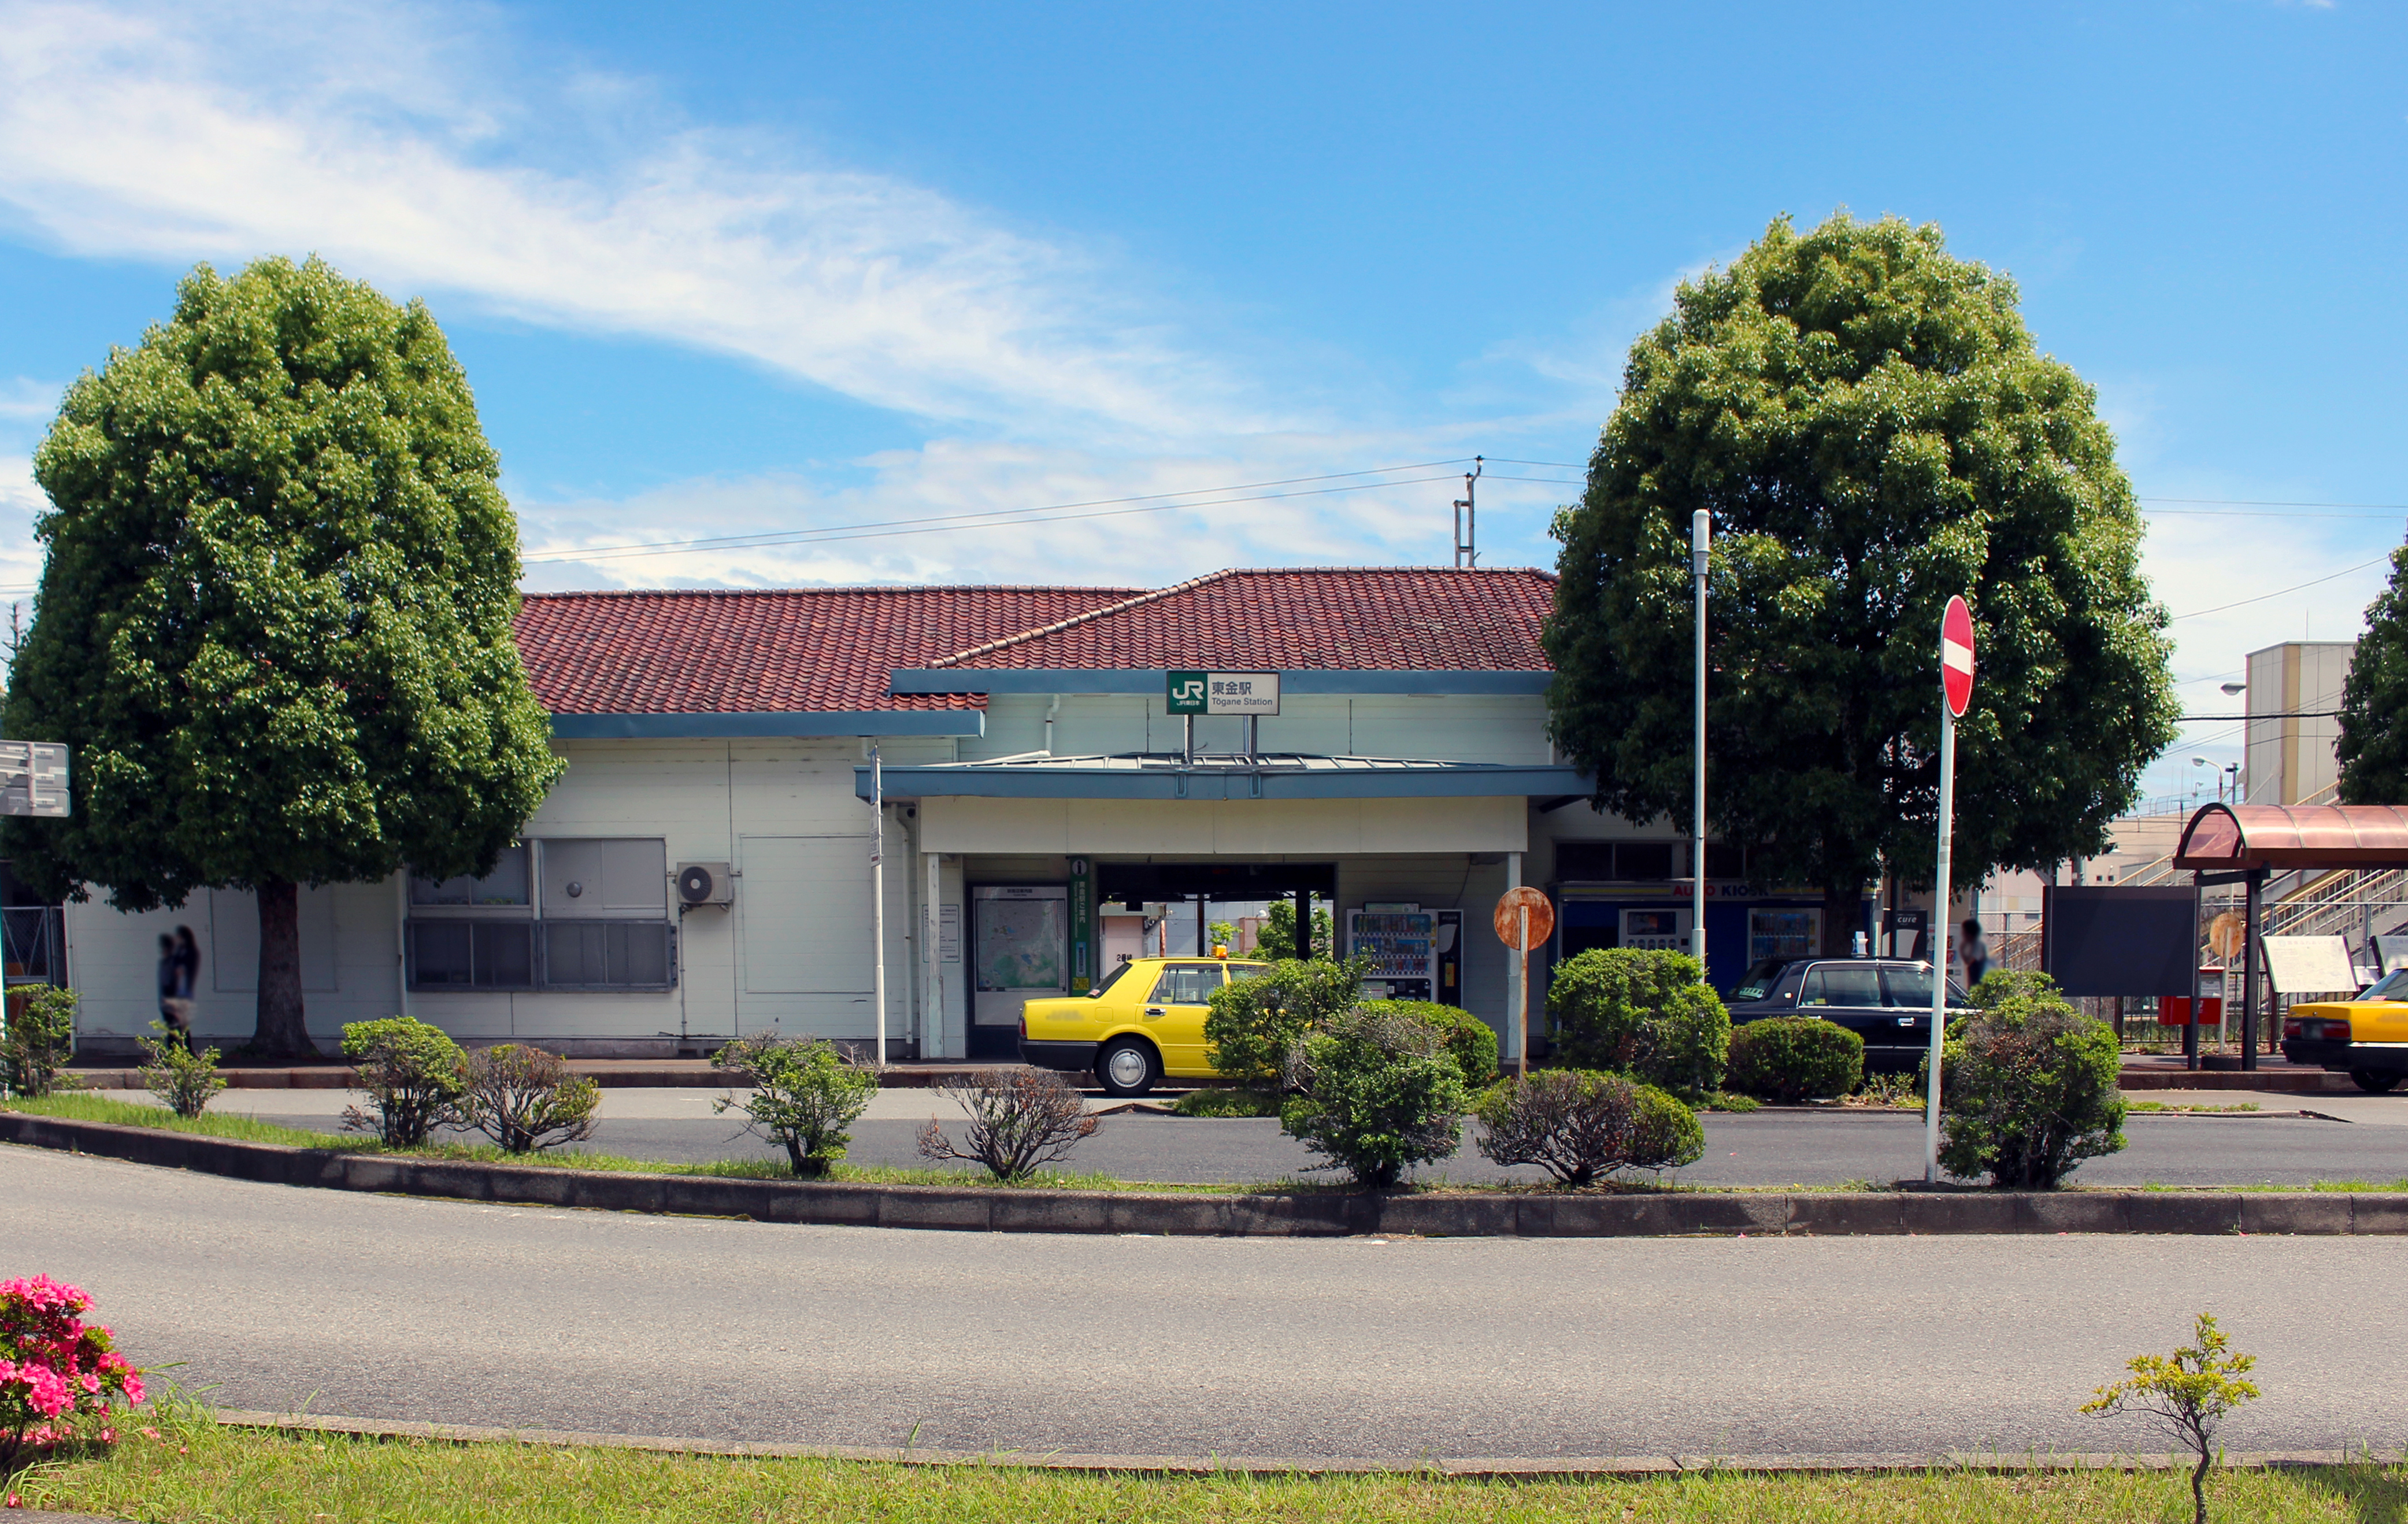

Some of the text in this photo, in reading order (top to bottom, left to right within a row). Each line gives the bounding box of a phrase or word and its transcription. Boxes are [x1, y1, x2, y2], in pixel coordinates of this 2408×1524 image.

[1173, 681, 1203, 699] JR
[1212, 682, 1251, 695] 東金駅
[1244, 697, 1273, 705] Station
[1673, 885, 1716, 897] AUO
